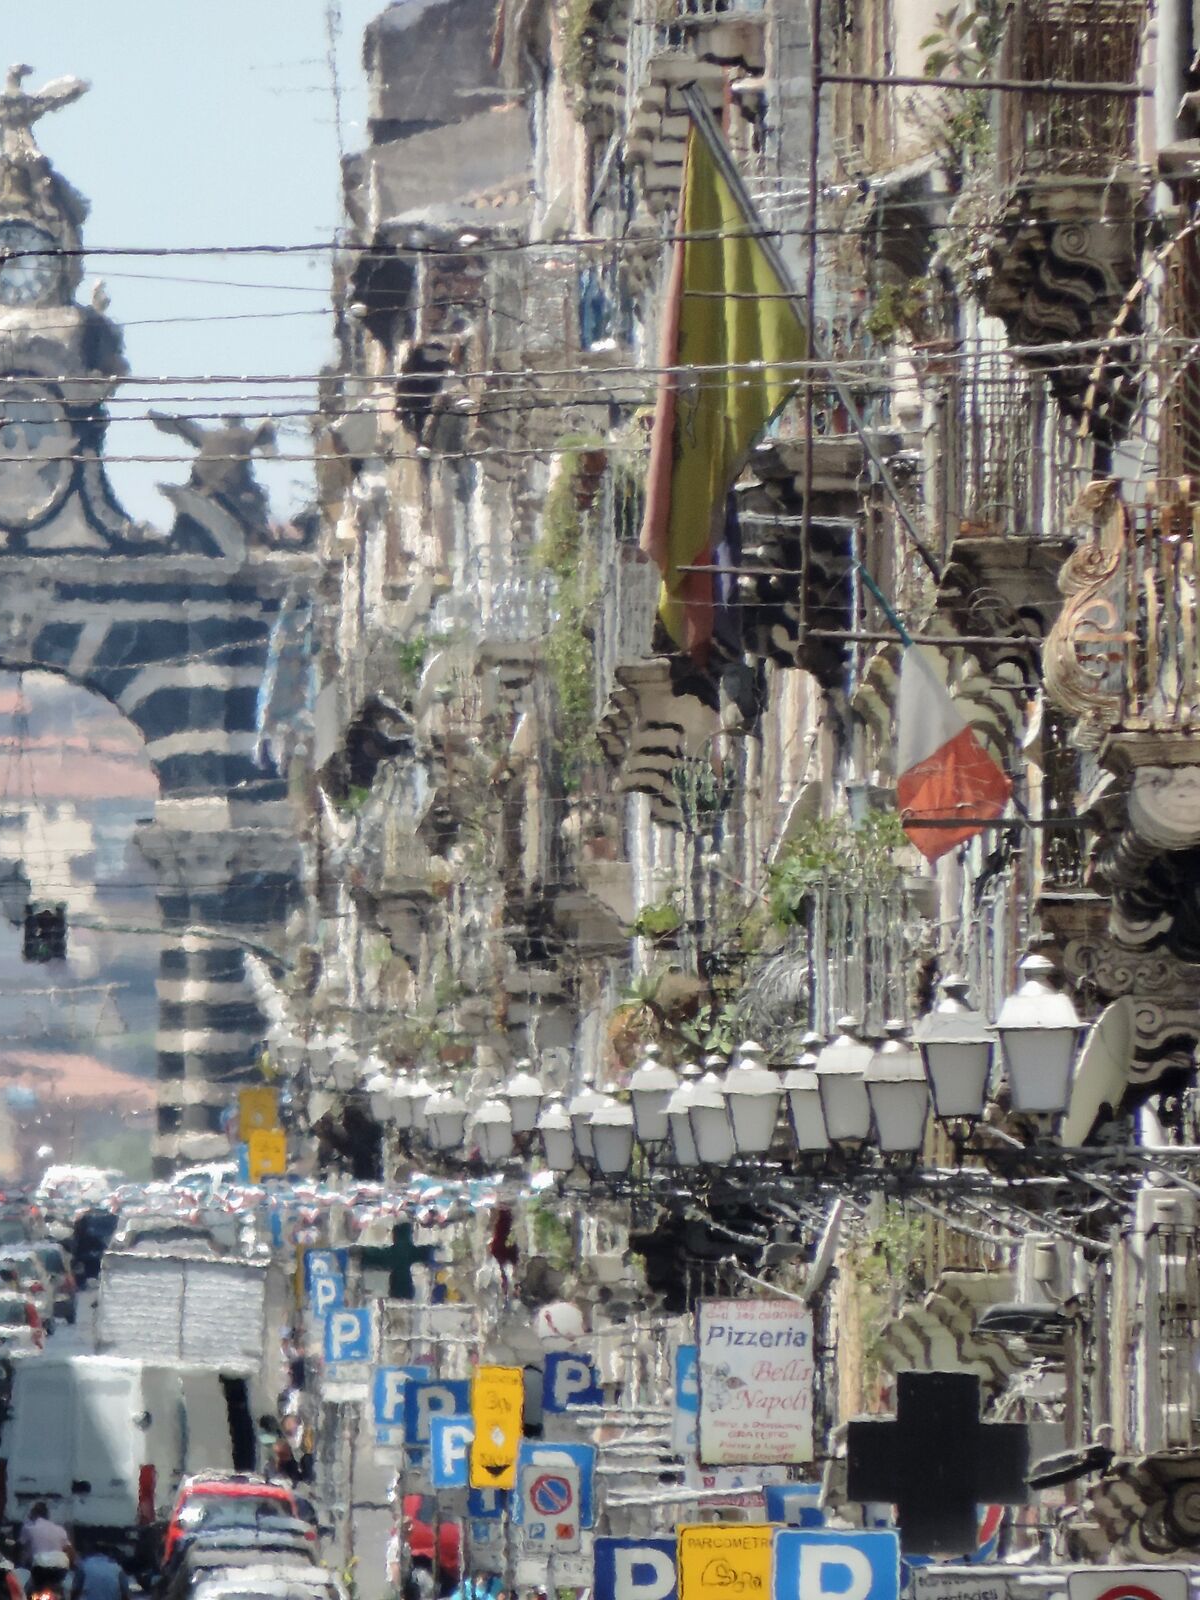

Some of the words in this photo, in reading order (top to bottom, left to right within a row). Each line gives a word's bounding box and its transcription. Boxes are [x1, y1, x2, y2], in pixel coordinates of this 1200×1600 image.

[331, 1313, 360, 1359] P
[705, 1326, 807, 1347] Pizzeria
[555, 1360, 590, 1407] P
[736, 1388, 808, 1419] Napoli
[416, 1387, 456, 1441] P
[614, 1547, 676, 1600] P
[799, 1544, 873, 1600] P
